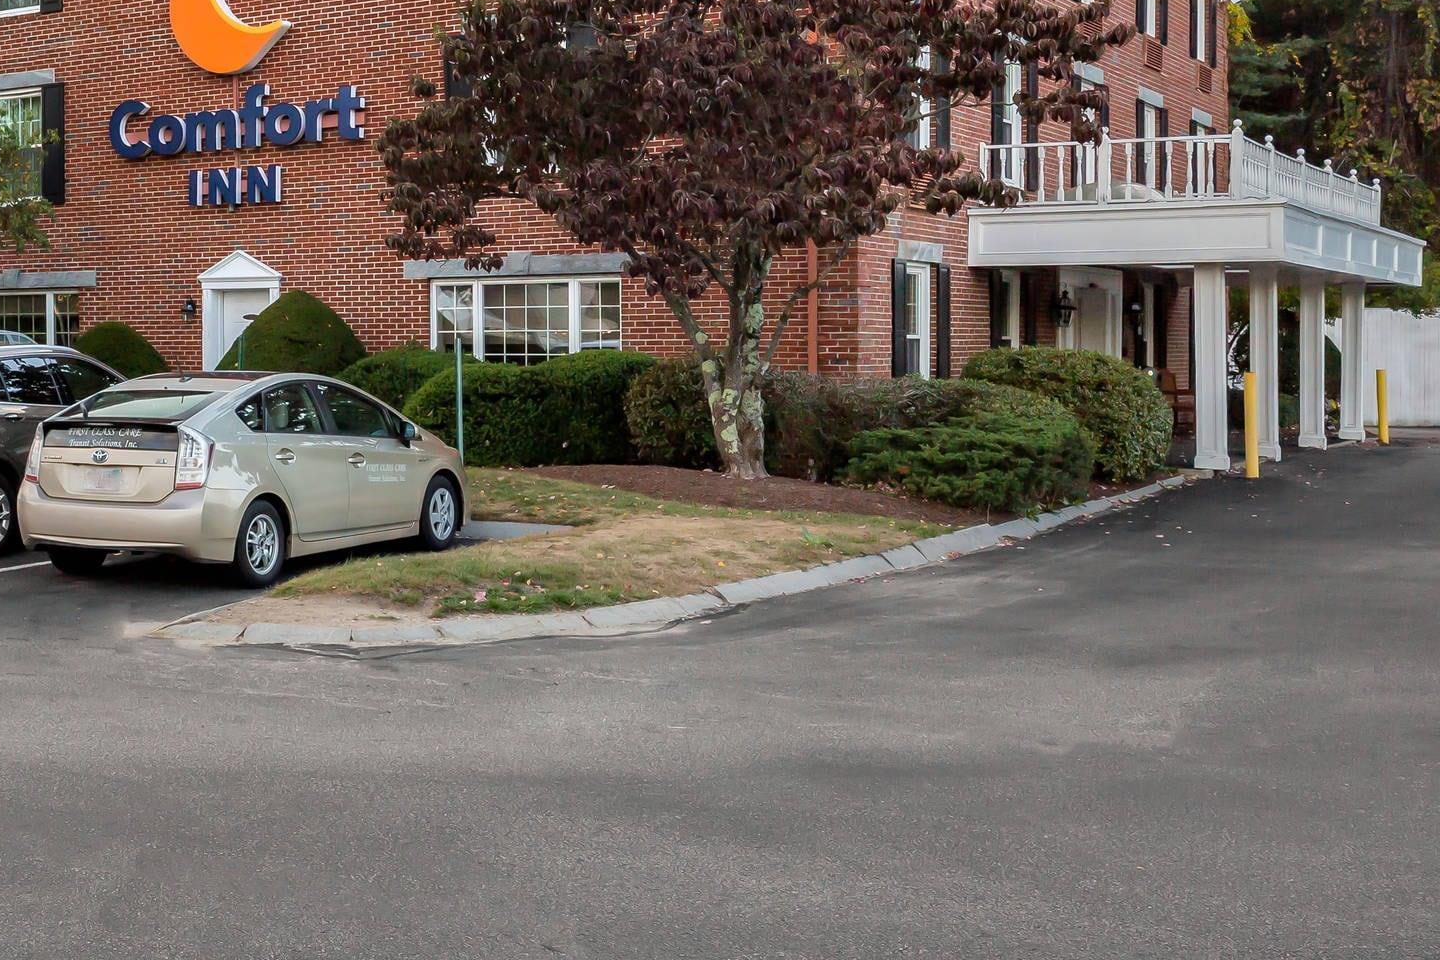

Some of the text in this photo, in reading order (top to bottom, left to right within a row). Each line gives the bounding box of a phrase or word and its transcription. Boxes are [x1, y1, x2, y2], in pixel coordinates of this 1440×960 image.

[109, 83, 366, 159] Comfort
[188, 164, 283, 207] INN
[69, 427, 143, 437] FIRST CLASS CARE
[124, 439, 138, 448] Inc.
